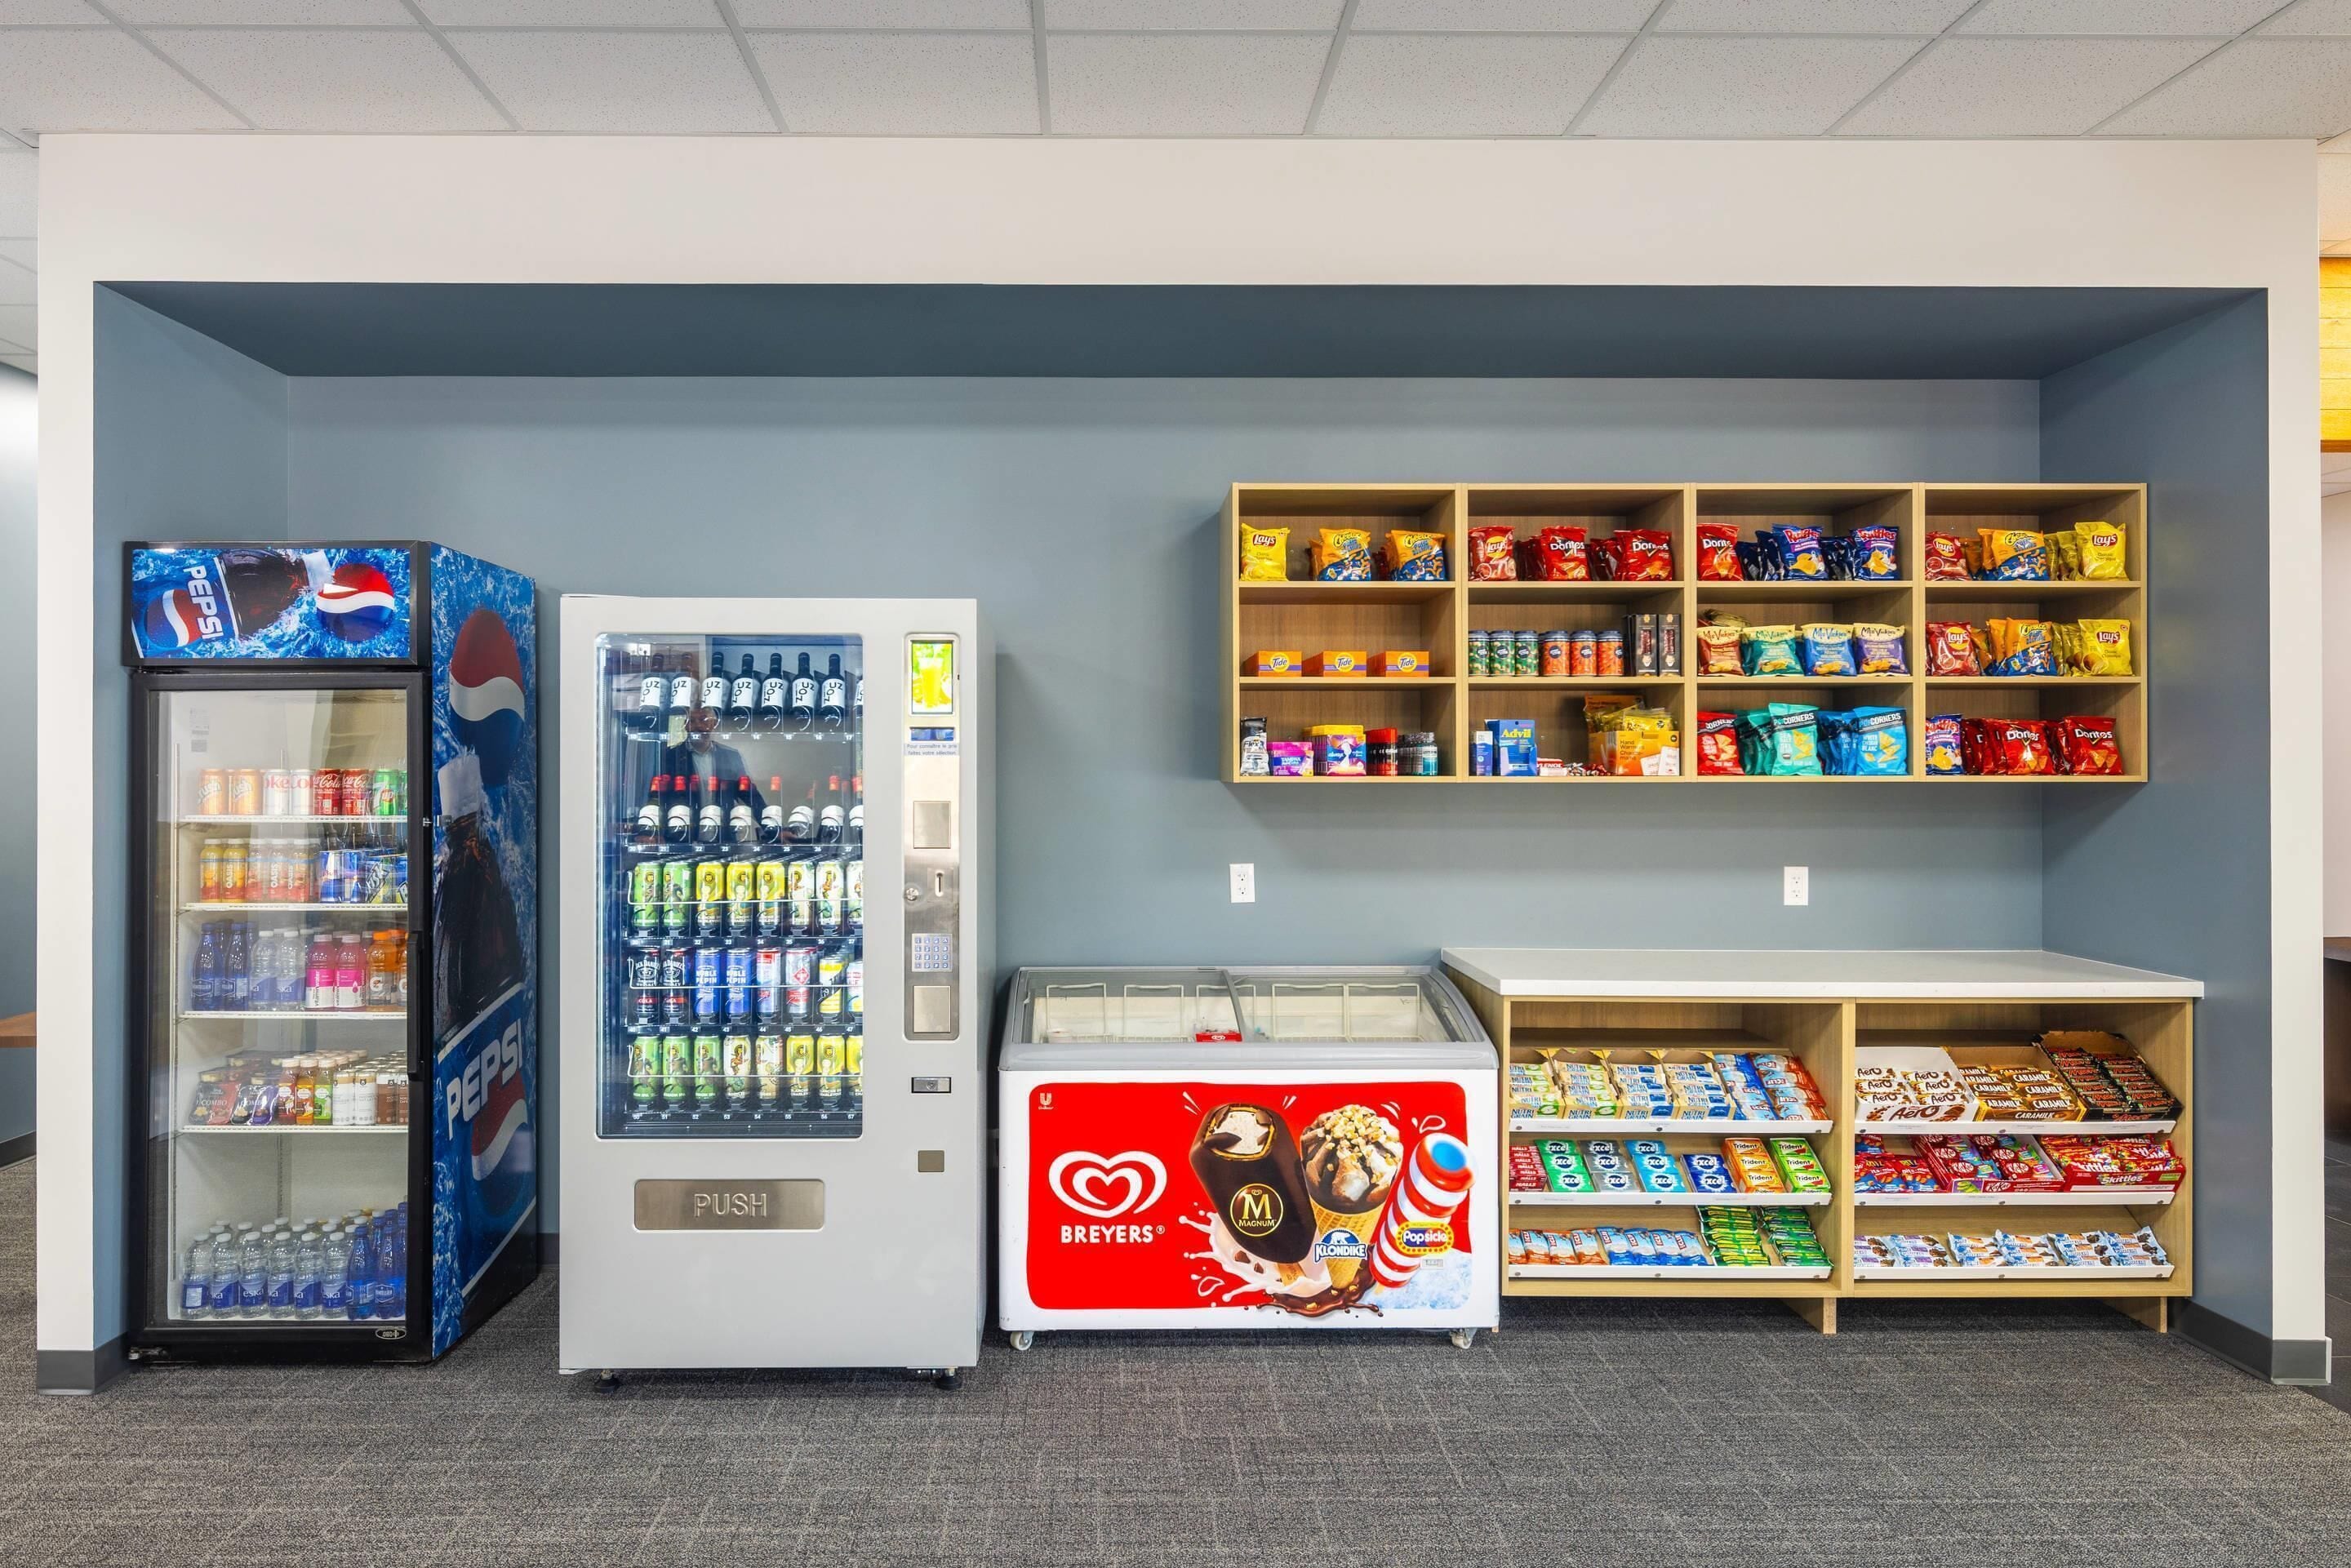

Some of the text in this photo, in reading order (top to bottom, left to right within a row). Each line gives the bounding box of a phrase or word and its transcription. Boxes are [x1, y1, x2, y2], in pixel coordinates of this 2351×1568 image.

[183, 565, 223, 640] PEPSI
[1272, 658, 1287, 668] Tide
[1337, 658, 1353, 668] Tide
[1400, 658, 1415, 668] Tide
[1502, 728, 1531, 739] Advil
[2075, 729, 2113, 739] Doritos
[1857, 1068, 1882, 1077] Aero
[1914, 1071, 1940, 1082] Aero
[2013, 1073, 2051, 1082] CARAMILK
[447, 1018, 523, 1141] PEPSI
[1868, 1080, 1893, 1089] Aero
[1965, 1076, 1999, 1084] ARAMILK
[1925, 1081, 1951, 1091] Aero
[1973, 1084, 2013, 1092] CARAMILK
[2024, 1086, 2064, 1095] CARAMILK
[1872, 1093, 1899, 1103] Aero
[1931, 1094, 1957, 1104] Aero
[2033, 1099, 2071, 1109] CARAMILK
[1889, 1105, 1941, 1122] Aero
[1747, 1174, 1773, 1182] Trident
[2100, 1174, 2143, 1185] Skittles
[694, 1193, 767, 1217] PUSH
[1238, 1219, 1275, 1228] MAGNUM
[1060, 1224, 1153, 1244] BREYERS
[1403, 1231, 1448, 1245] Popsicle
[1314, 1243, 1367, 1263] KLONDIKE
